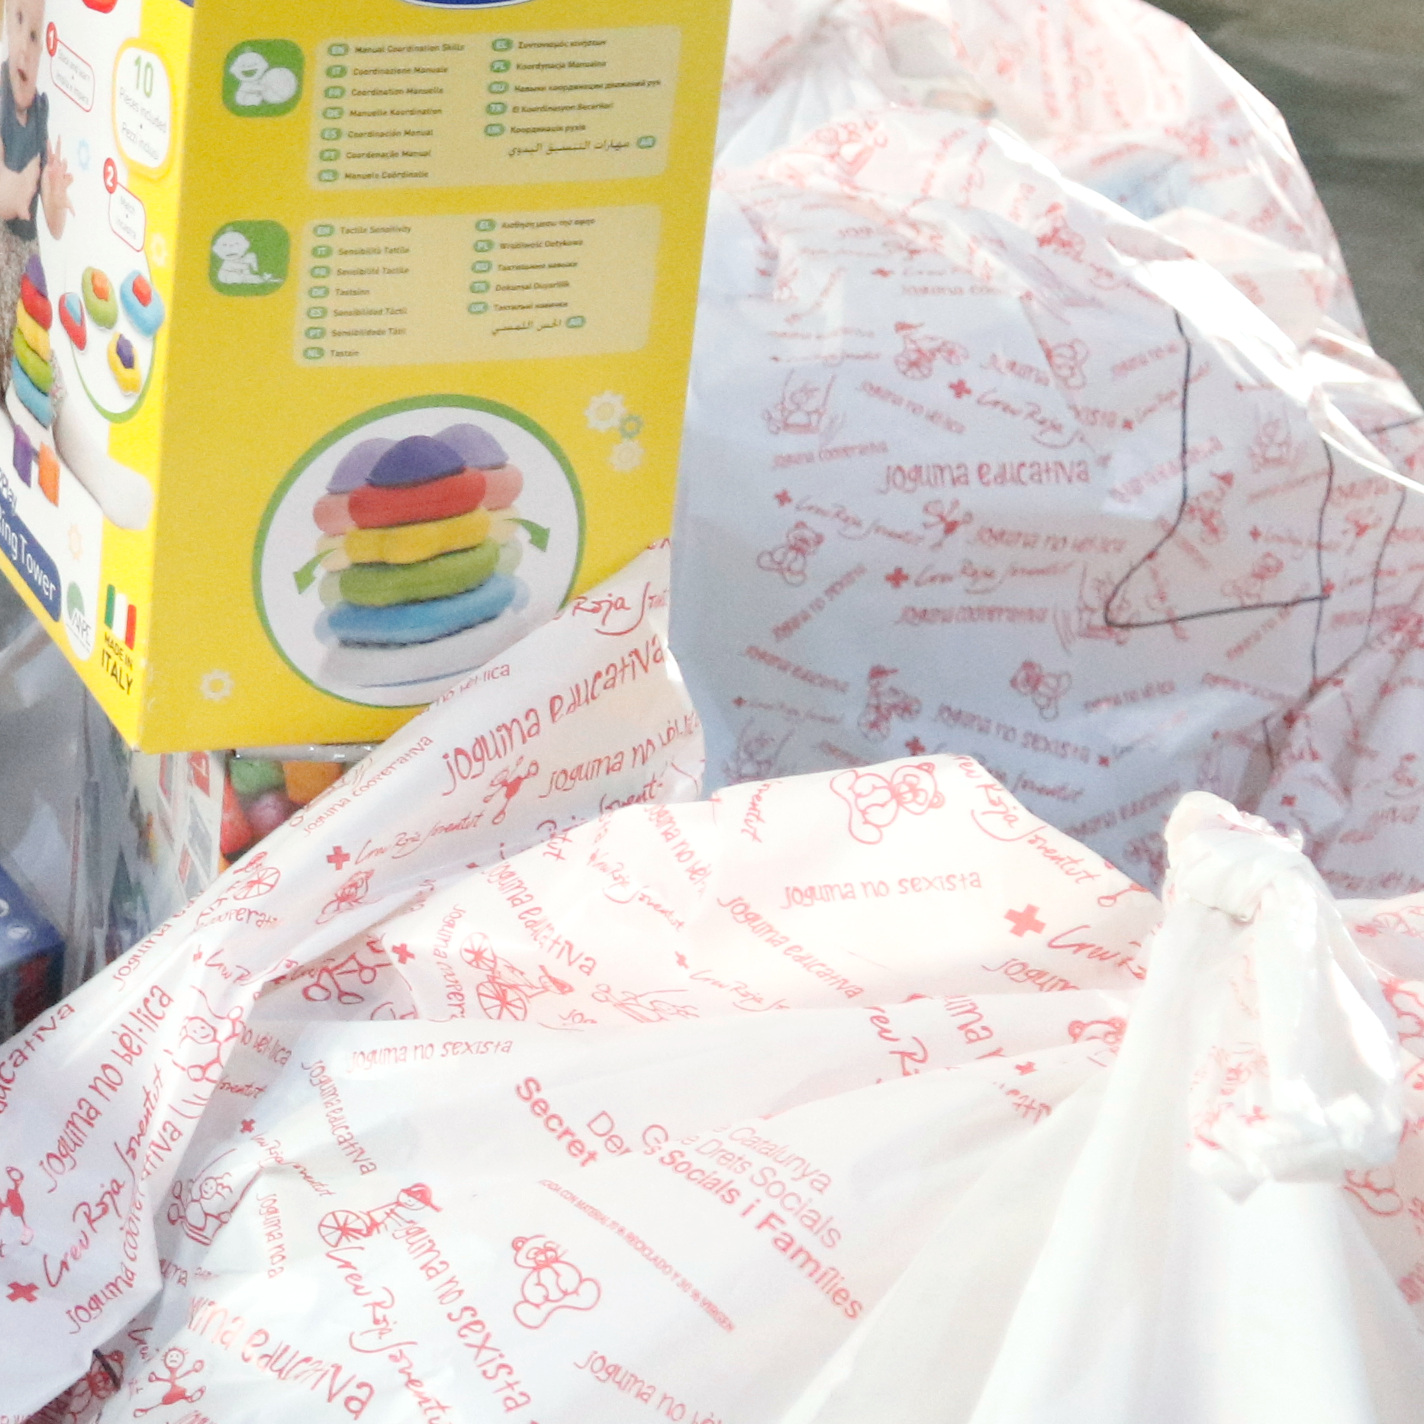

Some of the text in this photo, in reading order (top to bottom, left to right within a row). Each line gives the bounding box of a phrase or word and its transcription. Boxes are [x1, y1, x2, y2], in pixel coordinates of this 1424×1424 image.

[352, 67, 412, 76] Coordinazione
[354, 42, 465, 53] Manual Coordination Skills
[134, 54, 154, 99] 10
[351, 88, 405, 97] Coordination
[388, 106, 443, 117] Koordination
[403, 127, 435, 137] Manual
[106, 164, 115, 188] 2
[400, 148, 432, 158] Manual
[879, 459, 1091, 495] joguina educativa
[18, 533, 57, 601] Tower
[571, 592, 634, 620] Roja
[101, 650, 135, 696] ITALY
[103, 631, 134, 672] MADE IN
[441, 634, 667, 796] joguina educativa
[303, 734, 434, 838] joguina cooperativa
[538, 737, 657, 799] joguina no
[975, 781, 1021, 829] Roja
[971, 808, 1103, 885] Joventut
[779, 870, 984, 910] joguina no sexista
[716, 895, 866, 999] joguina educativa
[1046, 924, 1122, 961] Creu
[409, 1040, 436, 1063] no
[439, 1037, 514, 1060] sexista
[38, 983, 175, 1194] joguina no bèl·lica
[301, 1059, 379, 1177] joguina educativa
[40, 1067, 167, 1290] Creu Roja Joventut
[728, 1125, 833, 1194] Catalunya
[694, 1135, 842, 1250] Drets Socials
[657, 1147, 864, 1322] Socials i Famílies
[65, 1264, 137, 1335] joguina
[433, 1272, 532, 1414] no sexista
[243, 1328, 377, 1422] educativa
[573, 1349, 687, 1422] joguina no
